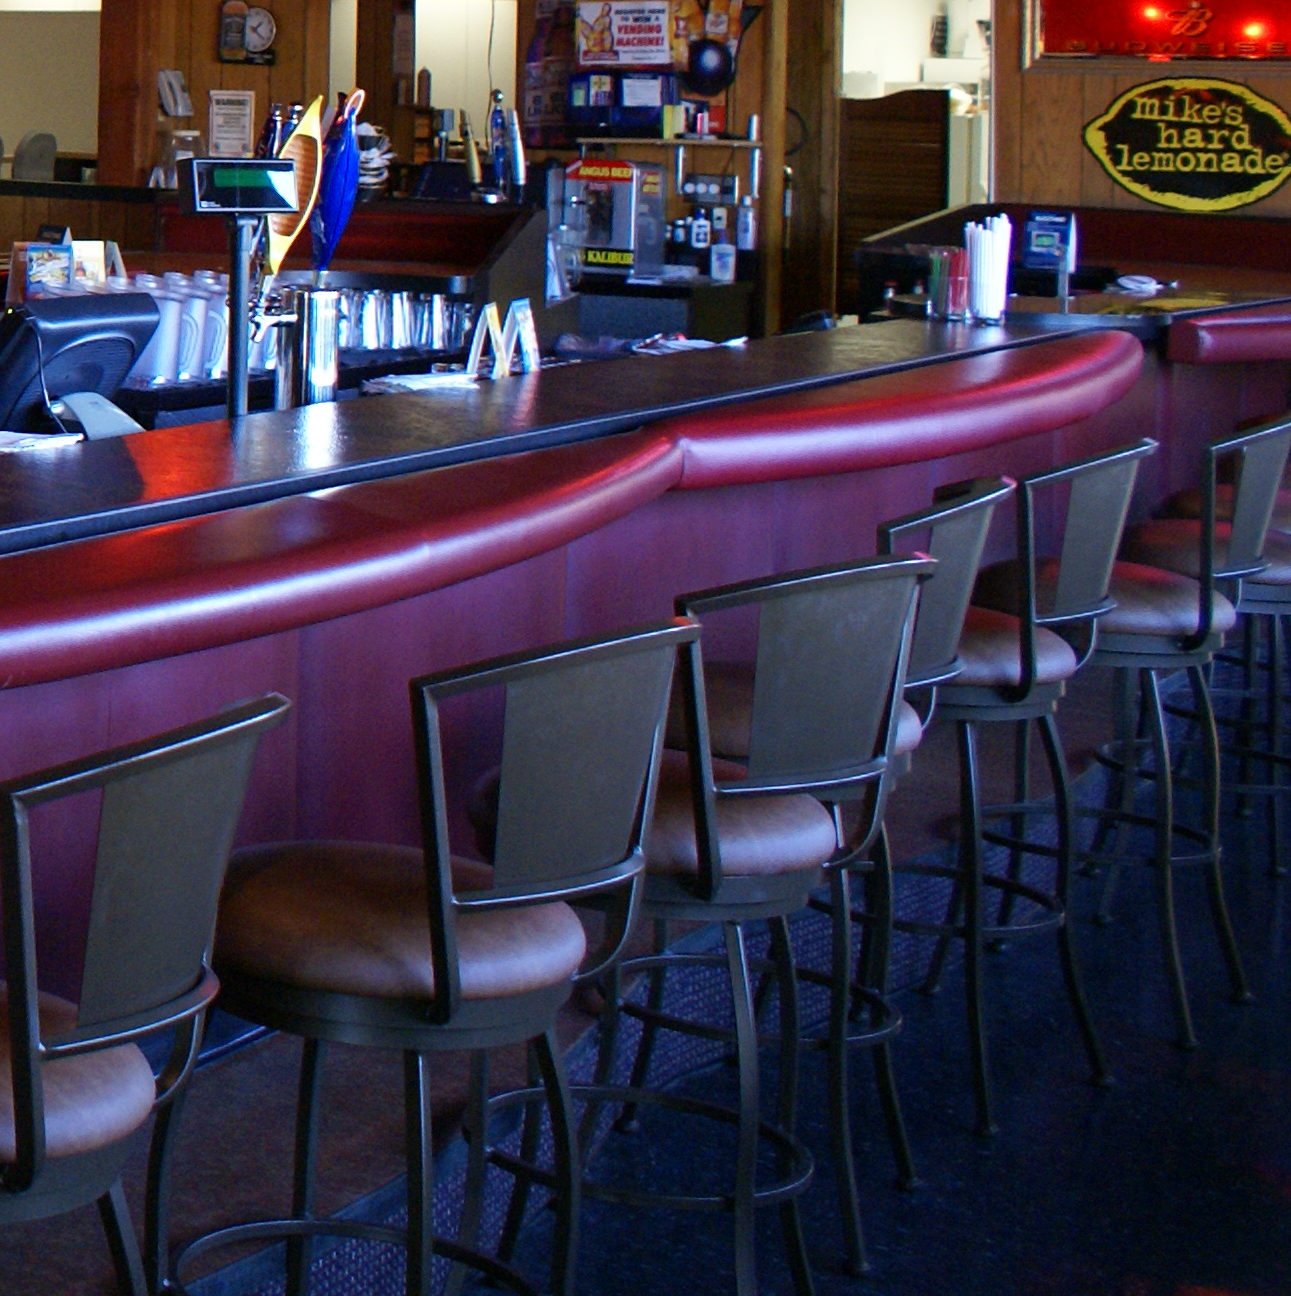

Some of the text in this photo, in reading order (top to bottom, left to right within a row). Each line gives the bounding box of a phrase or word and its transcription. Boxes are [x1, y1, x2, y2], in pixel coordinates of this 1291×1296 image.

[617, 24, 662, 35] VENDING
[616, 36, 665, 47] MACHINE!
[1130, 95, 1243, 125] mike's
[1156, 122, 1255, 150] hard
[1115, 144, 1285, 174] lemonade
[578, 166, 610, 177] ANGUS
